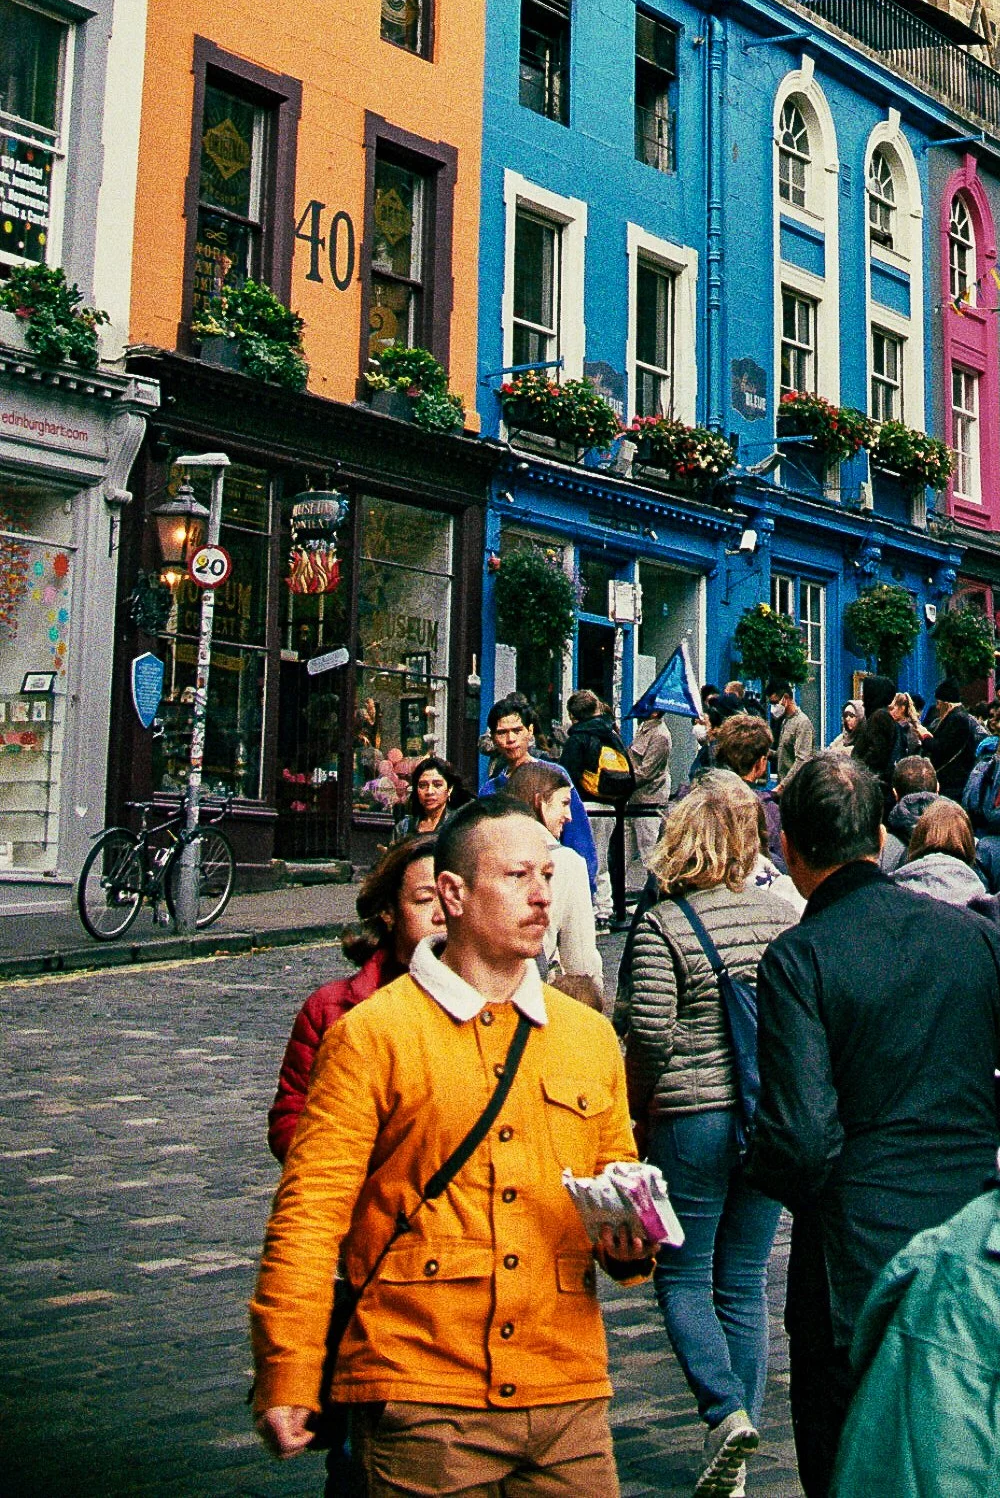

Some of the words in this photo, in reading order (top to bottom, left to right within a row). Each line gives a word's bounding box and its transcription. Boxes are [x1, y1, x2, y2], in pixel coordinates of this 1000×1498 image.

[294, 200, 355, 292] 40
[1, 411, 88, 441] edinburghart.com
[195, 558, 226, 577] 20
